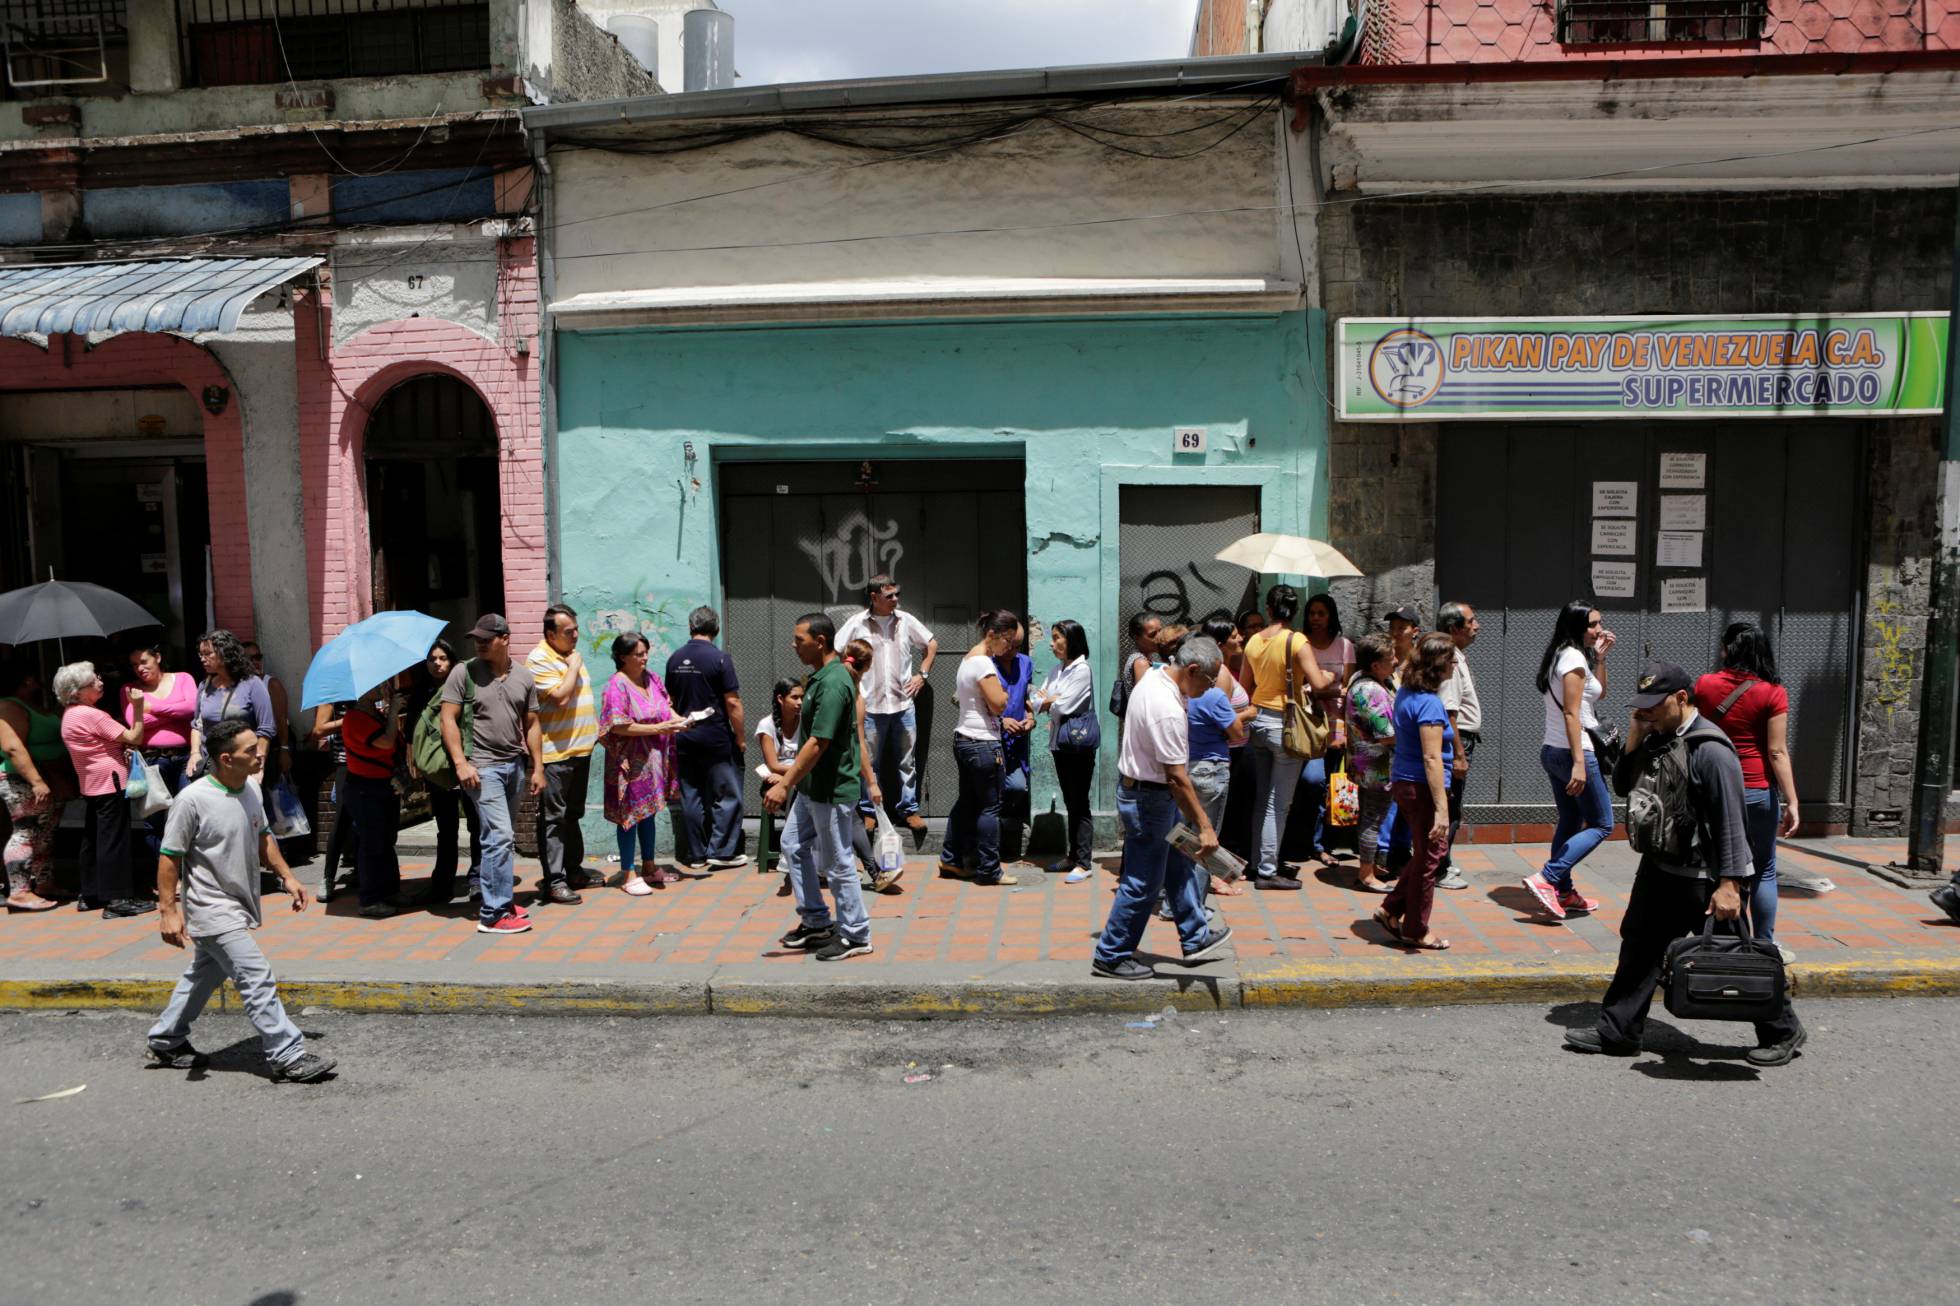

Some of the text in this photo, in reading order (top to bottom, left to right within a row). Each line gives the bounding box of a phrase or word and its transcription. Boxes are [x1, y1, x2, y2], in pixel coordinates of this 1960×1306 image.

[408, 275, 424, 290] 67
[1451, 332, 1881, 370] PIKAN PAY DE VENEZUELA C.A.
[1624, 374, 1880, 406] SUPERMERCADO
[1182, 433, 1200, 448] 69
